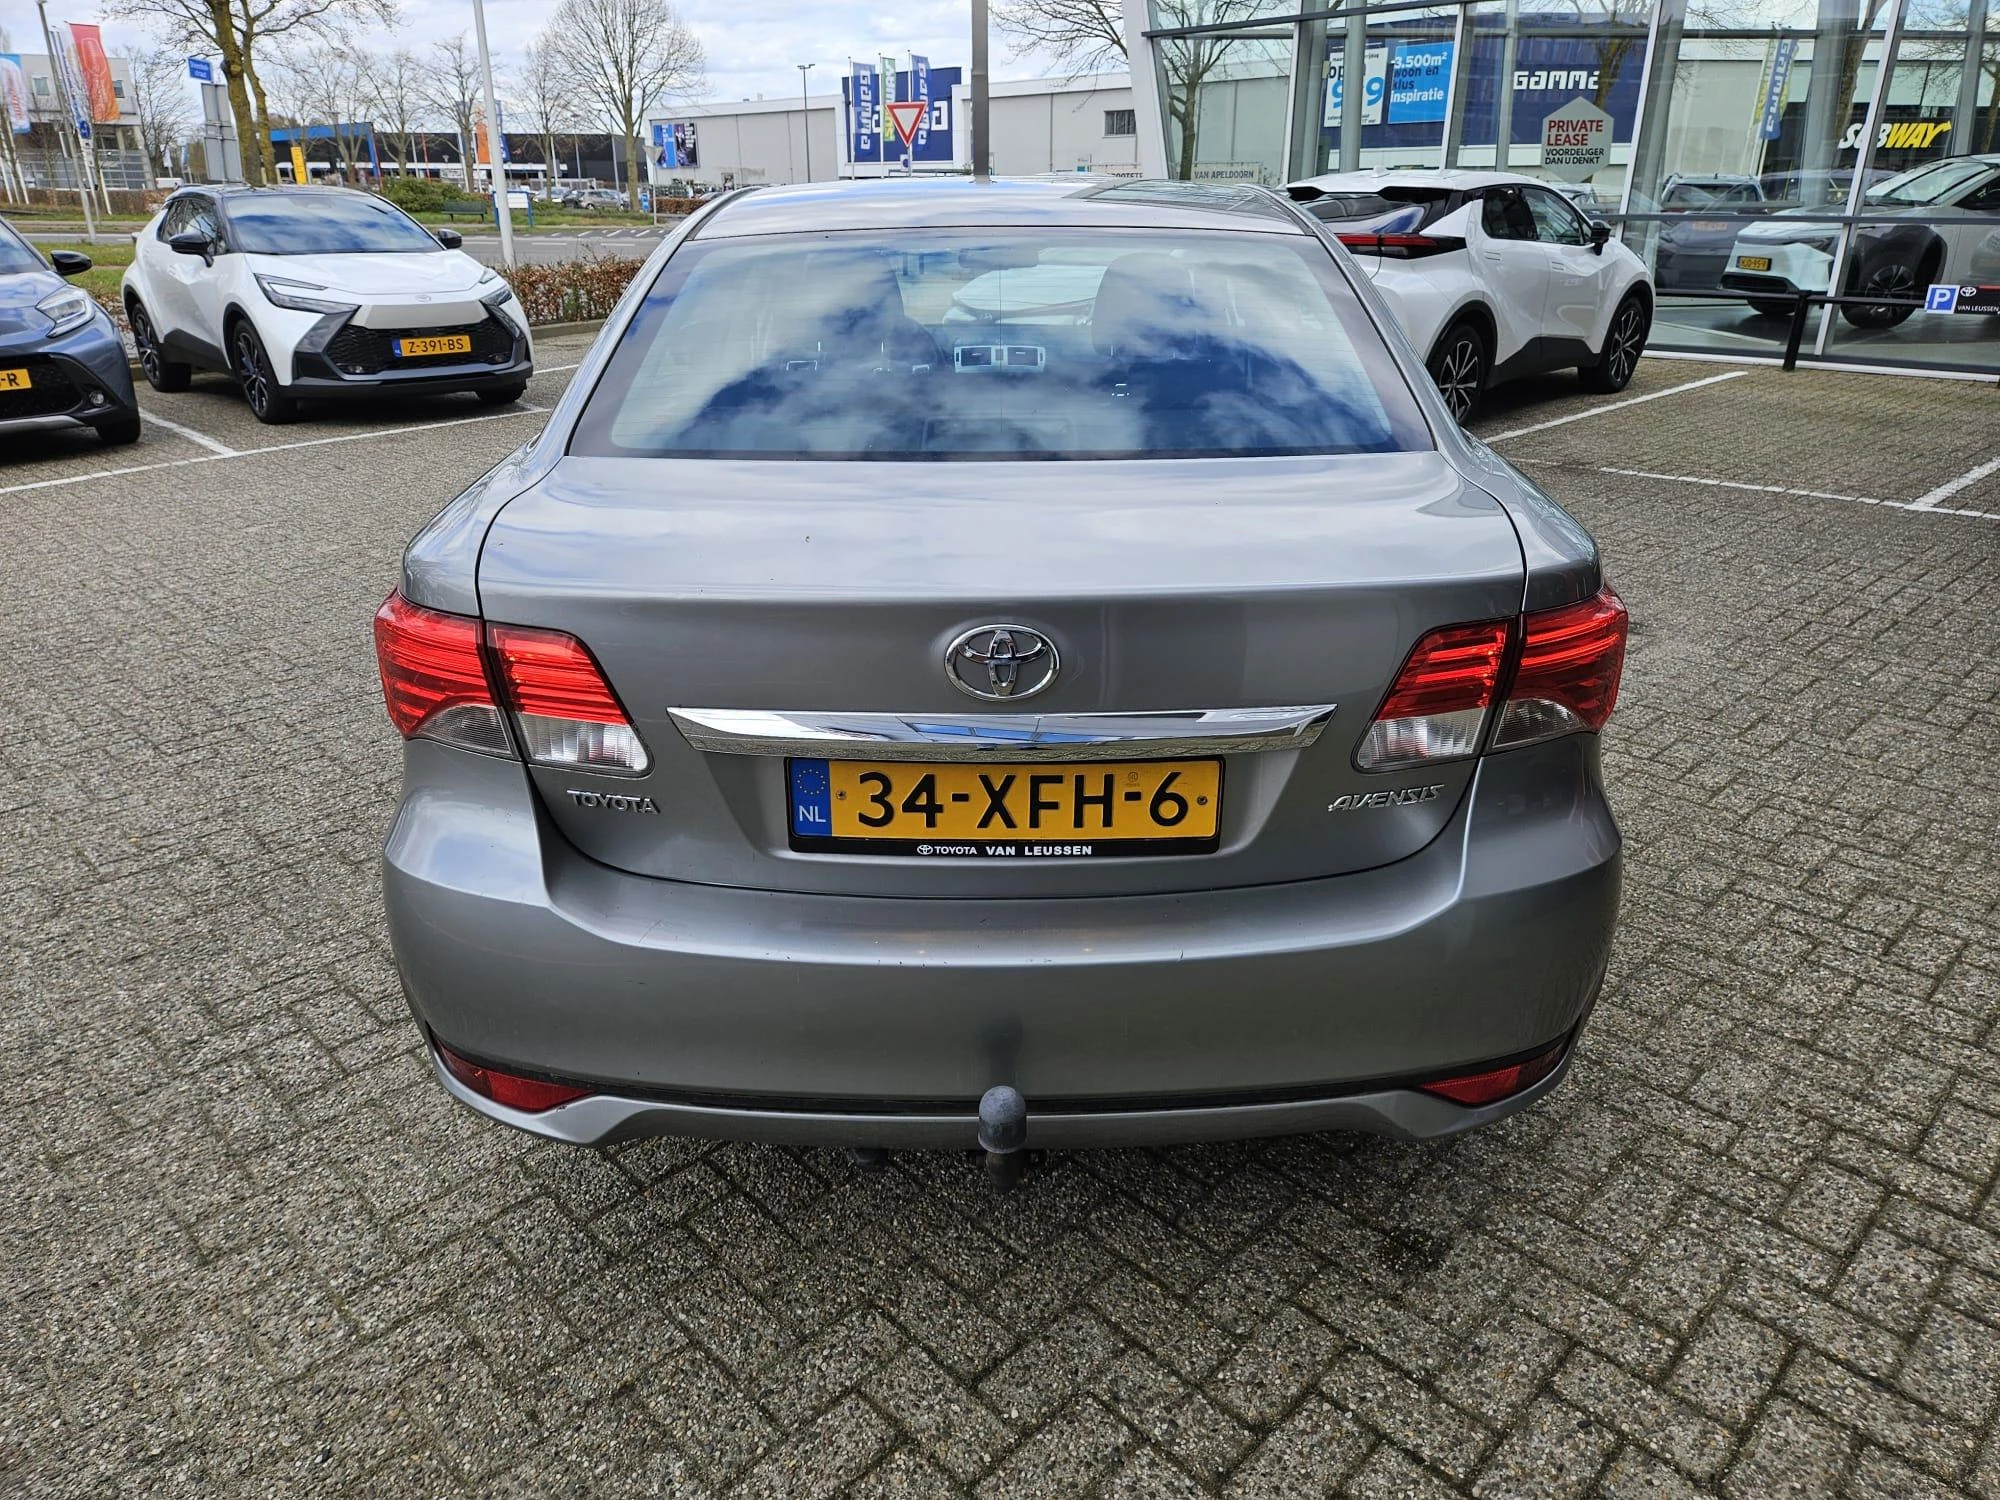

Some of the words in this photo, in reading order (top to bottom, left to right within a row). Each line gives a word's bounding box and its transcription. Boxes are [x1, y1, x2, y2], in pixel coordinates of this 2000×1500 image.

[1426, 66, 1439, 76] en
[1366, 77, 1384, 106] 9
[1391, 88, 1445, 104] inspiratie
[883, 60, 896, 141] SUWAY
[1547, 120, 1604, 133] PRIVATE
[1547, 134, 1589, 146] LEASE
[1545, 148, 1605, 157] VOORDELIGER
[1544, 157, 1563, 165] DAN
[1564, 157, 1571, 165] U
[1572, 157, 1600, 165] DENKT
[1194, 170, 1209, 179] VAN
[1211, 170, 1254, 179] APELDOORN
[1932, 288, 1951, 309] P
[408, 338, 464, 353] Z-391-BS
[0, 372, 20, 387] -R
[566, 788, 659, 815] TOYOTA
[799, 805, 826, 823] NL
[857, 771, 1189, 829] 34-XFH-6
[1327, 784, 1445, 812] AVENSIS
[934, 846, 977, 855] TOYOTA
[985, 846, 1016, 856] VAN
[1024, 845, 1092, 856] LEUSSEN
